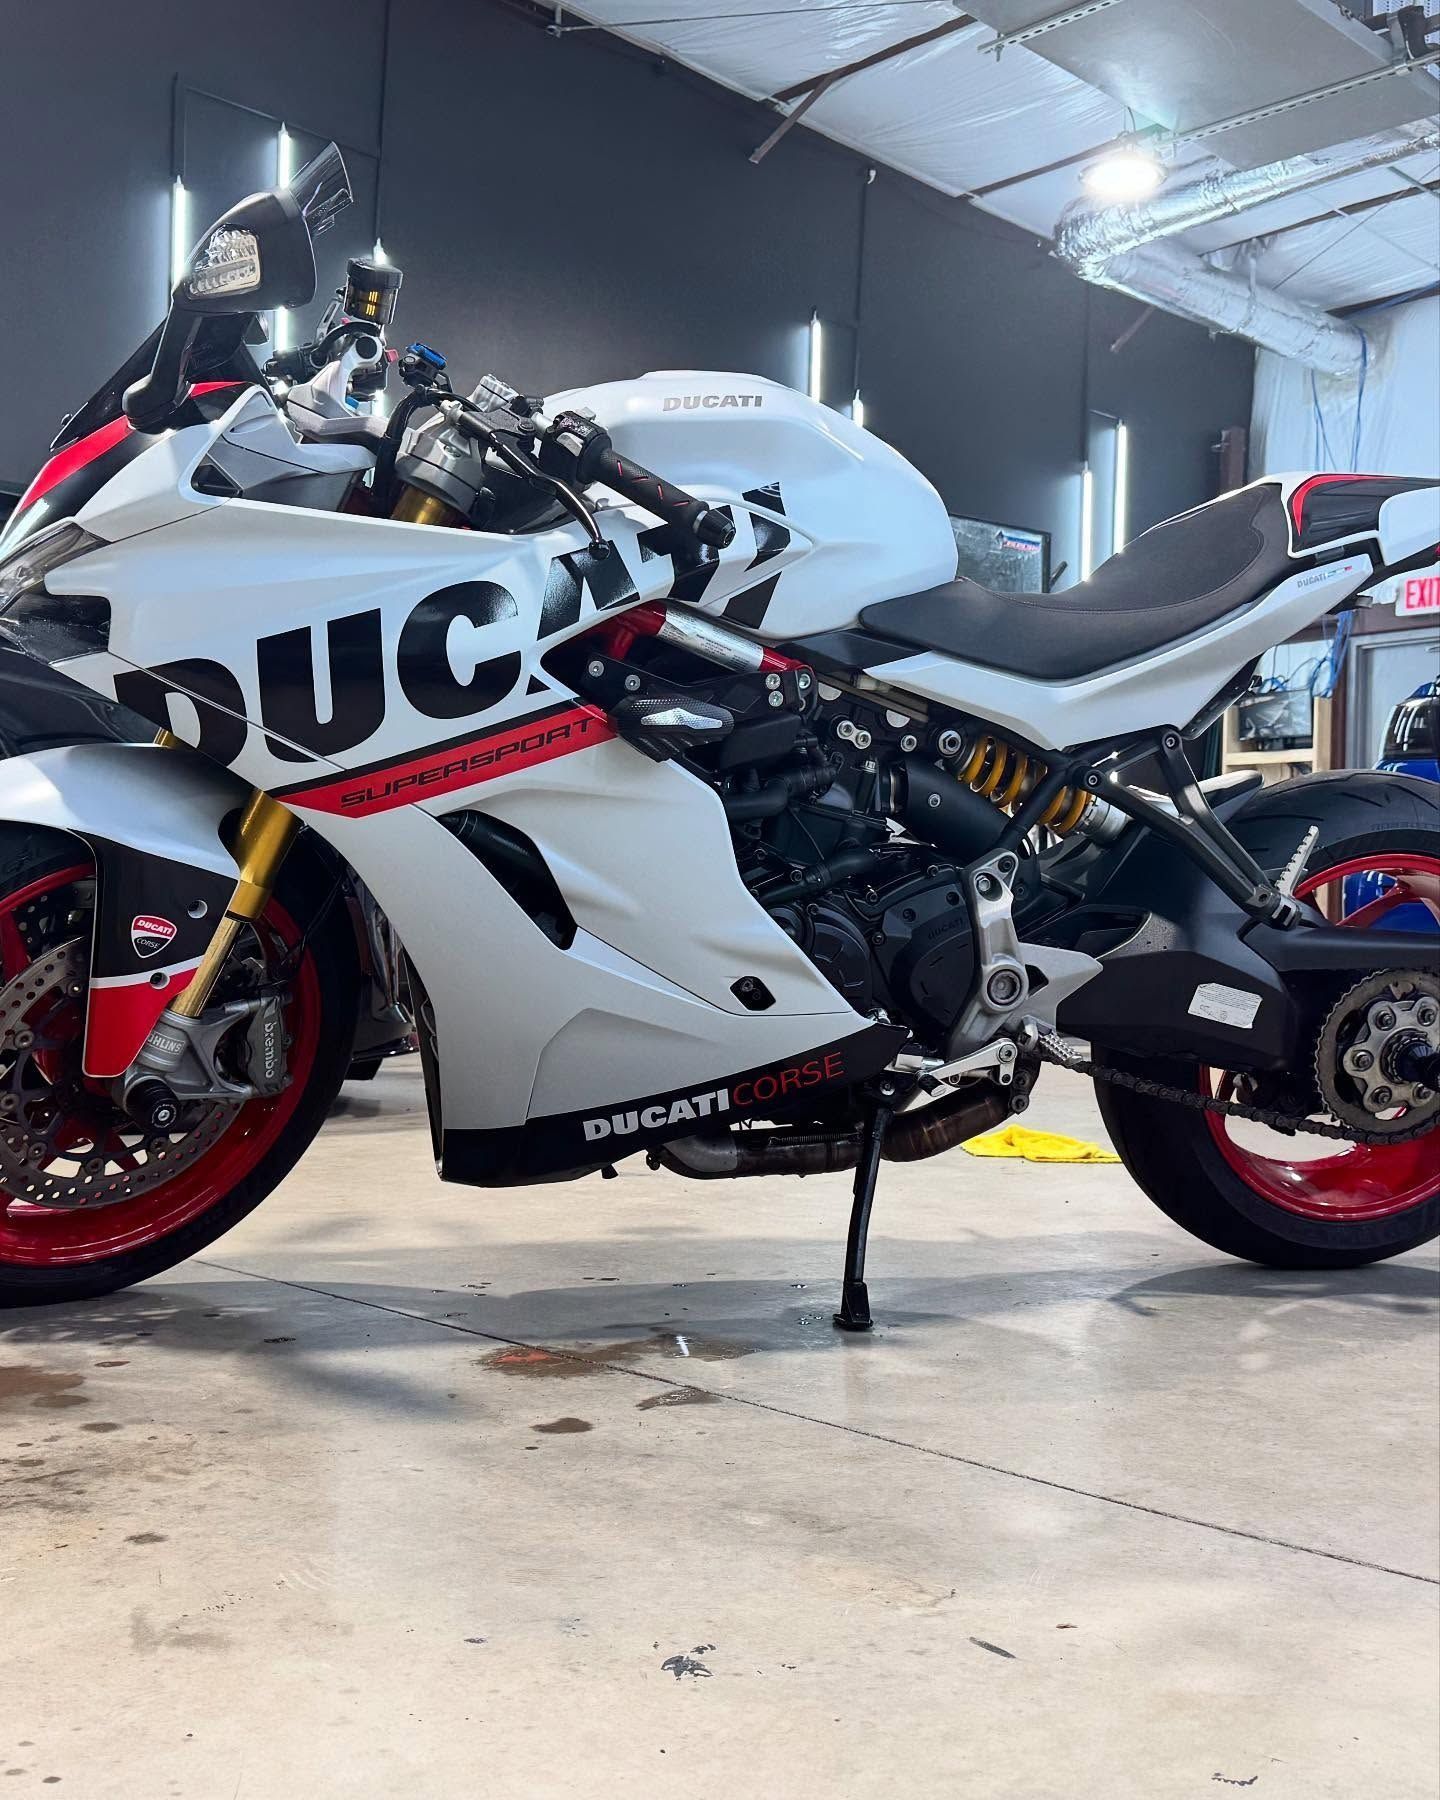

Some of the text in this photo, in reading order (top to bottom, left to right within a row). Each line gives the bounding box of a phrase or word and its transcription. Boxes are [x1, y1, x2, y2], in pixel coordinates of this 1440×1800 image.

[662, 395, 763, 412] DUCATI
[1296, 572, 1326, 589] DUCATI
[340, 717, 596, 808] SUPERSPORT
[137, 919, 173, 935] DUCATI
[136, 938, 160, 949] CORSE
[264, 1021, 277, 1079] brembo
[582, 1051, 845, 1141] DUCATI CORSE
